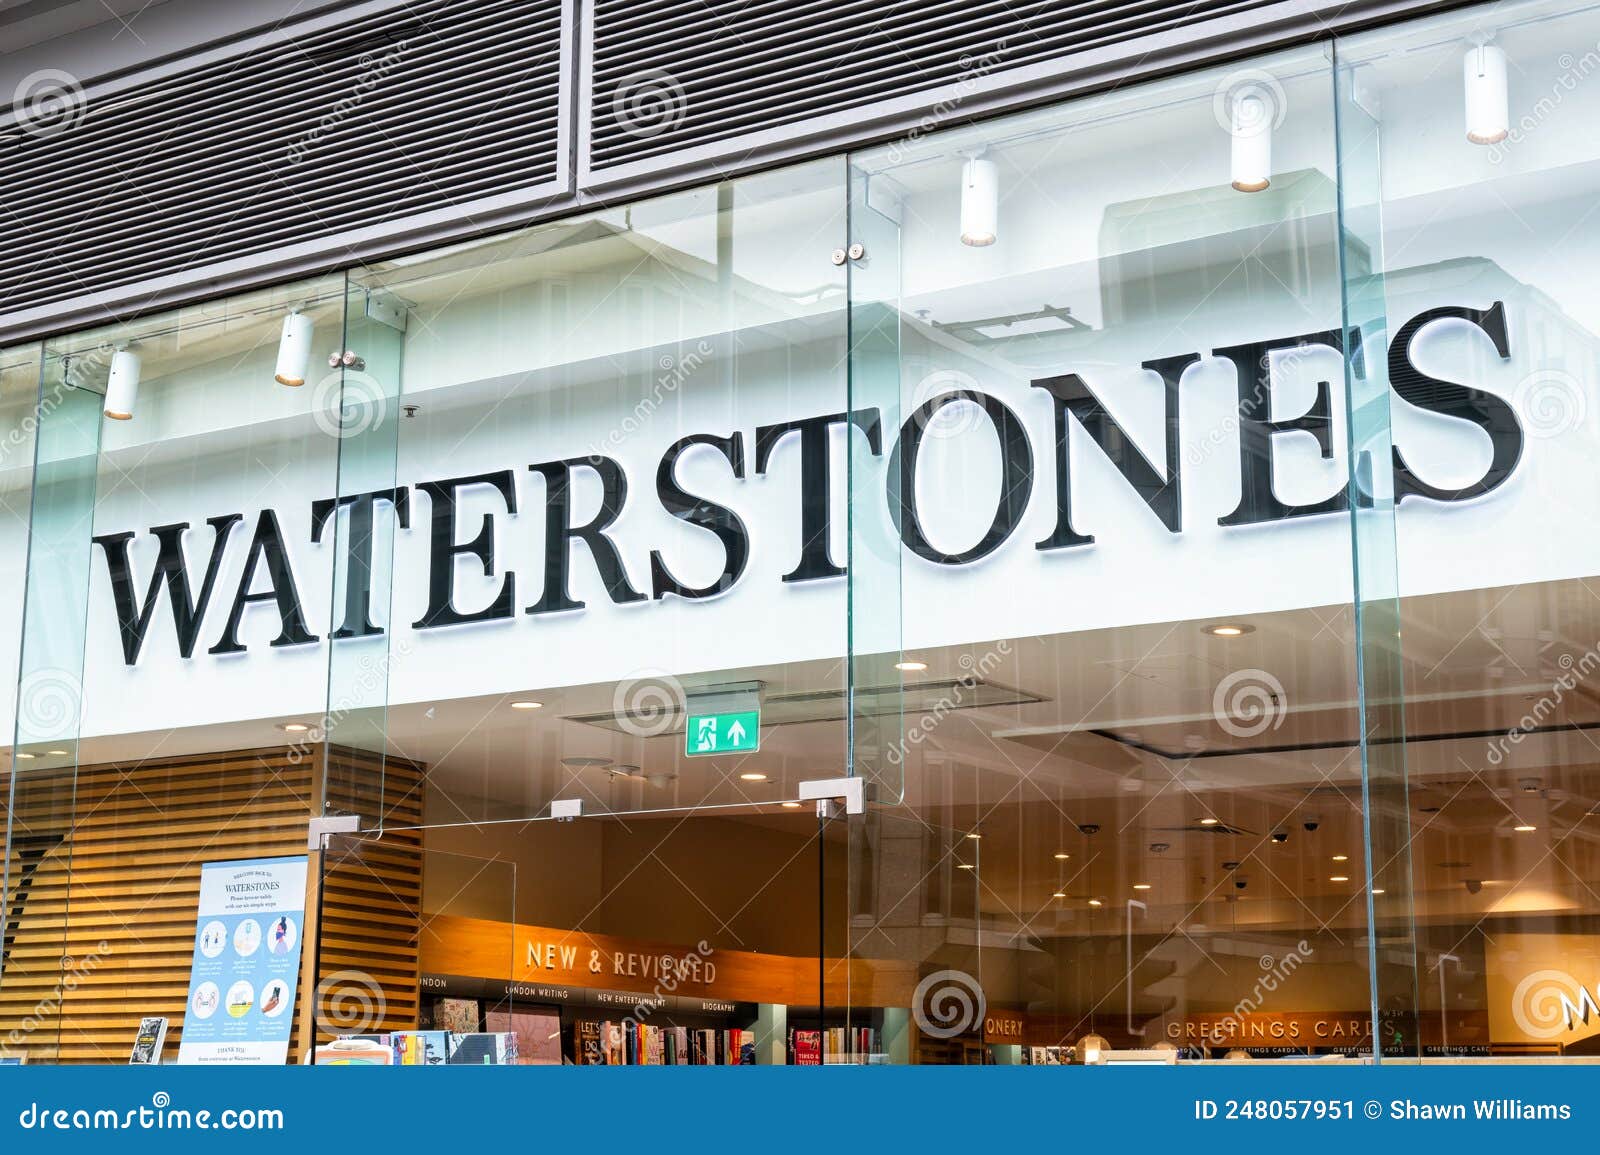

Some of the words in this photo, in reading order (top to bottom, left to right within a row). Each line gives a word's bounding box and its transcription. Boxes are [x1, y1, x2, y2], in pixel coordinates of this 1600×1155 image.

[93, 300, 1525, 667] WATERSTONES
[225, 881, 280, 892] WATERSTONES
[526, 941, 577, 970] NEW
[588, 949, 602, 973] &
[614, 951, 716, 984] REVIEWED
[419, 977, 447, 988] NDON
[505, 986, 536, 996] LONDON
[538, 988, 568, 999] WRITING
[598, 993, 613, 1002] NEW
[615, 995, 666, 1007] ENTERTAINMENT
[702, 1002, 736, 1012] BIOGRAPHY
[1167, 1021, 1300, 1038] GREETINGS
